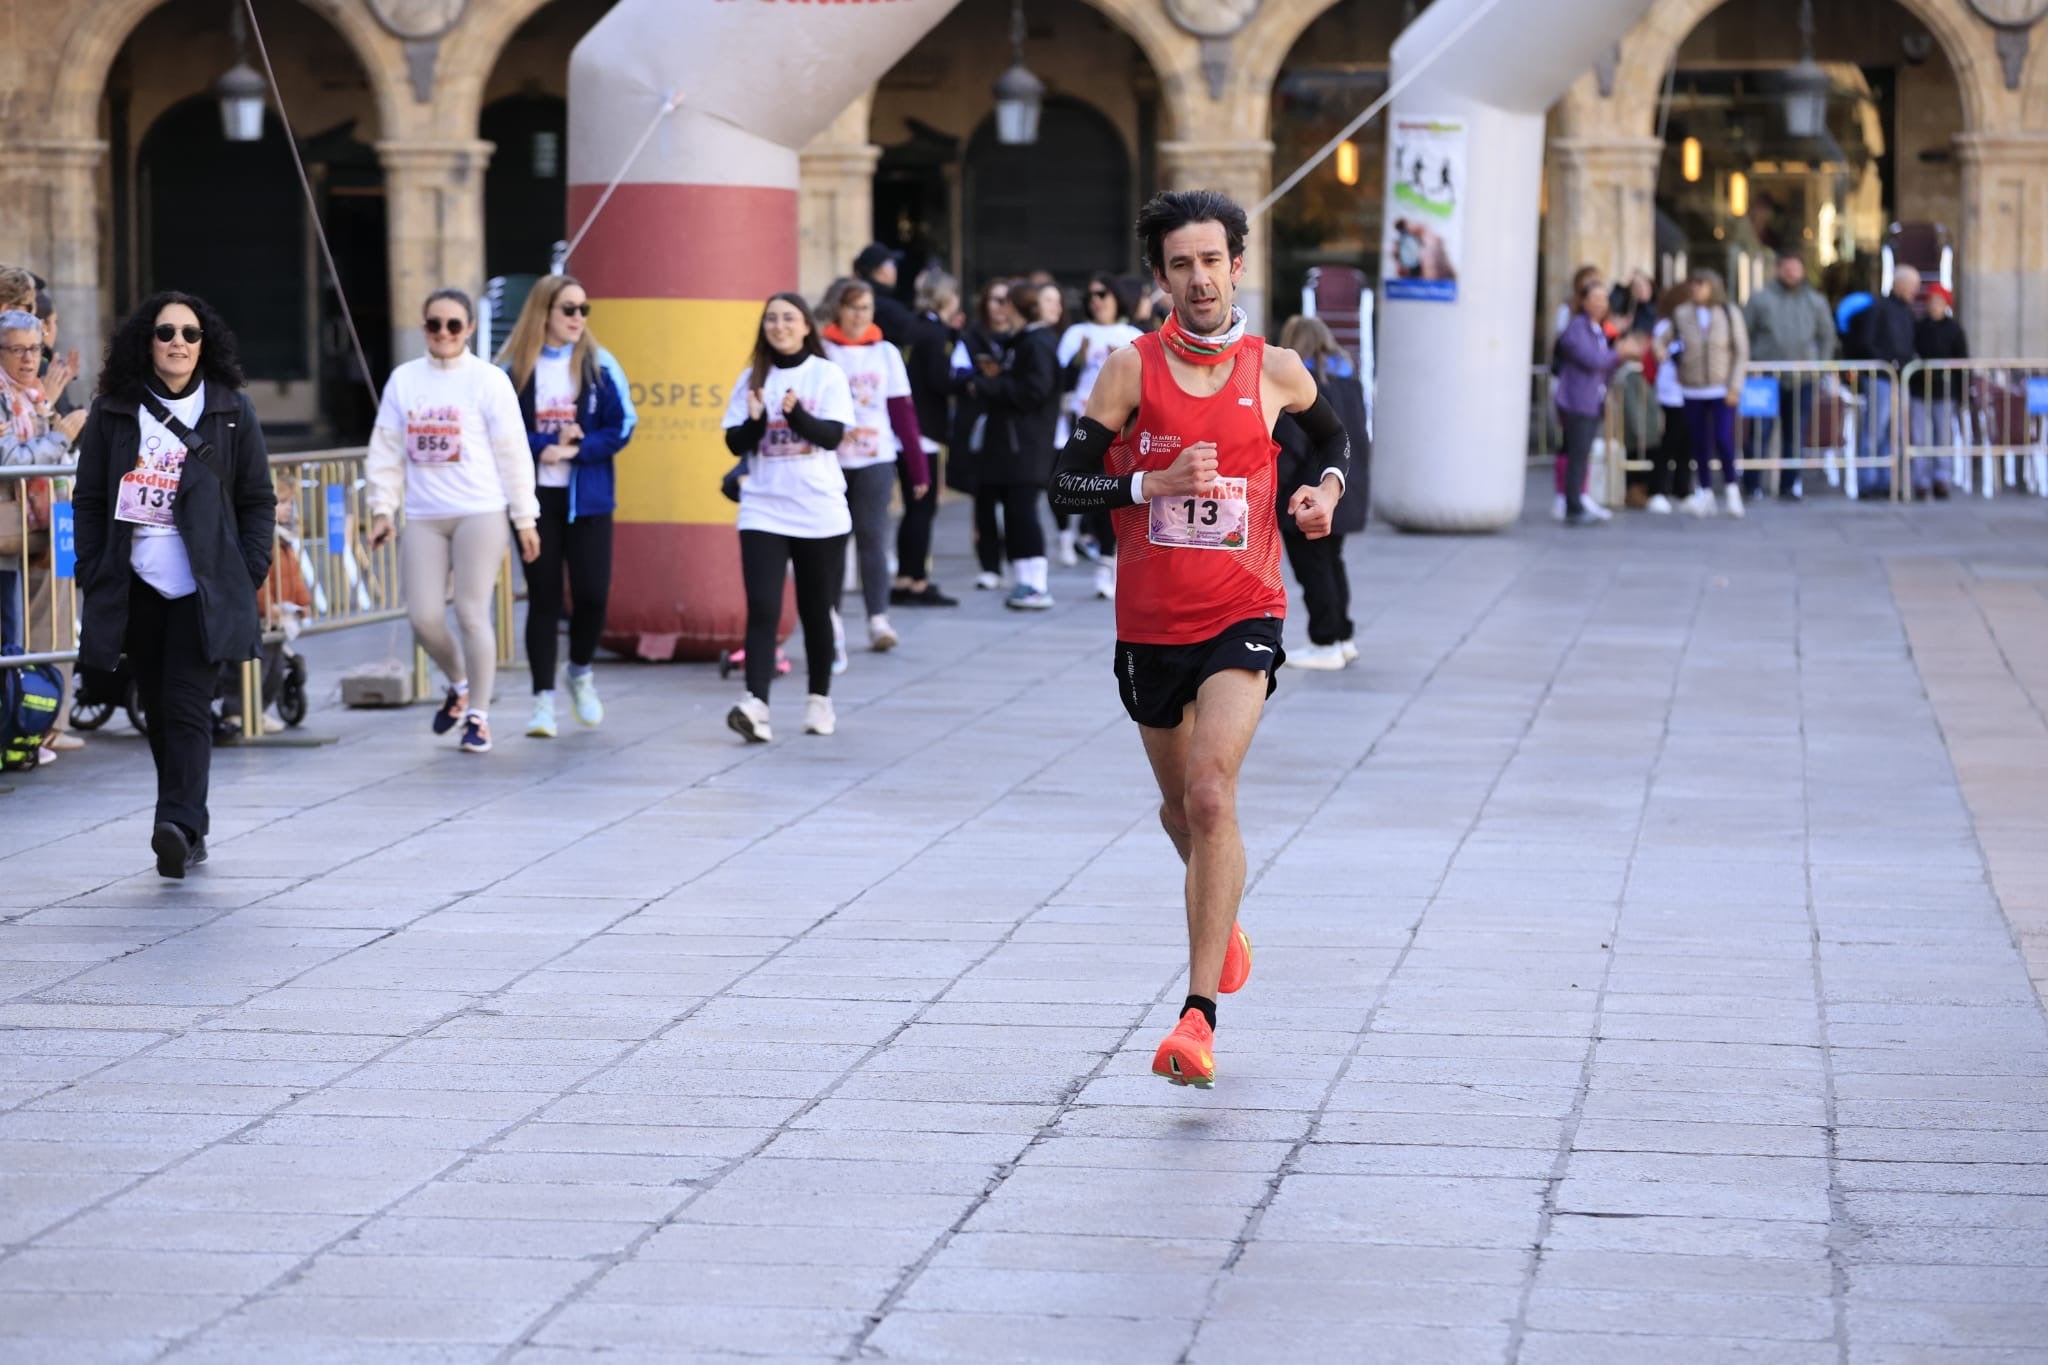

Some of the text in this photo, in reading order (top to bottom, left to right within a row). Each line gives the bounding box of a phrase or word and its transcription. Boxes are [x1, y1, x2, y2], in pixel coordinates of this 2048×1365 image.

[631, 383, 723, 408] OSPES
[417, 435, 449, 452] 856
[1054, 494, 1106, 507] ZAMORANA
[1183, 499, 1218, 525] 13
